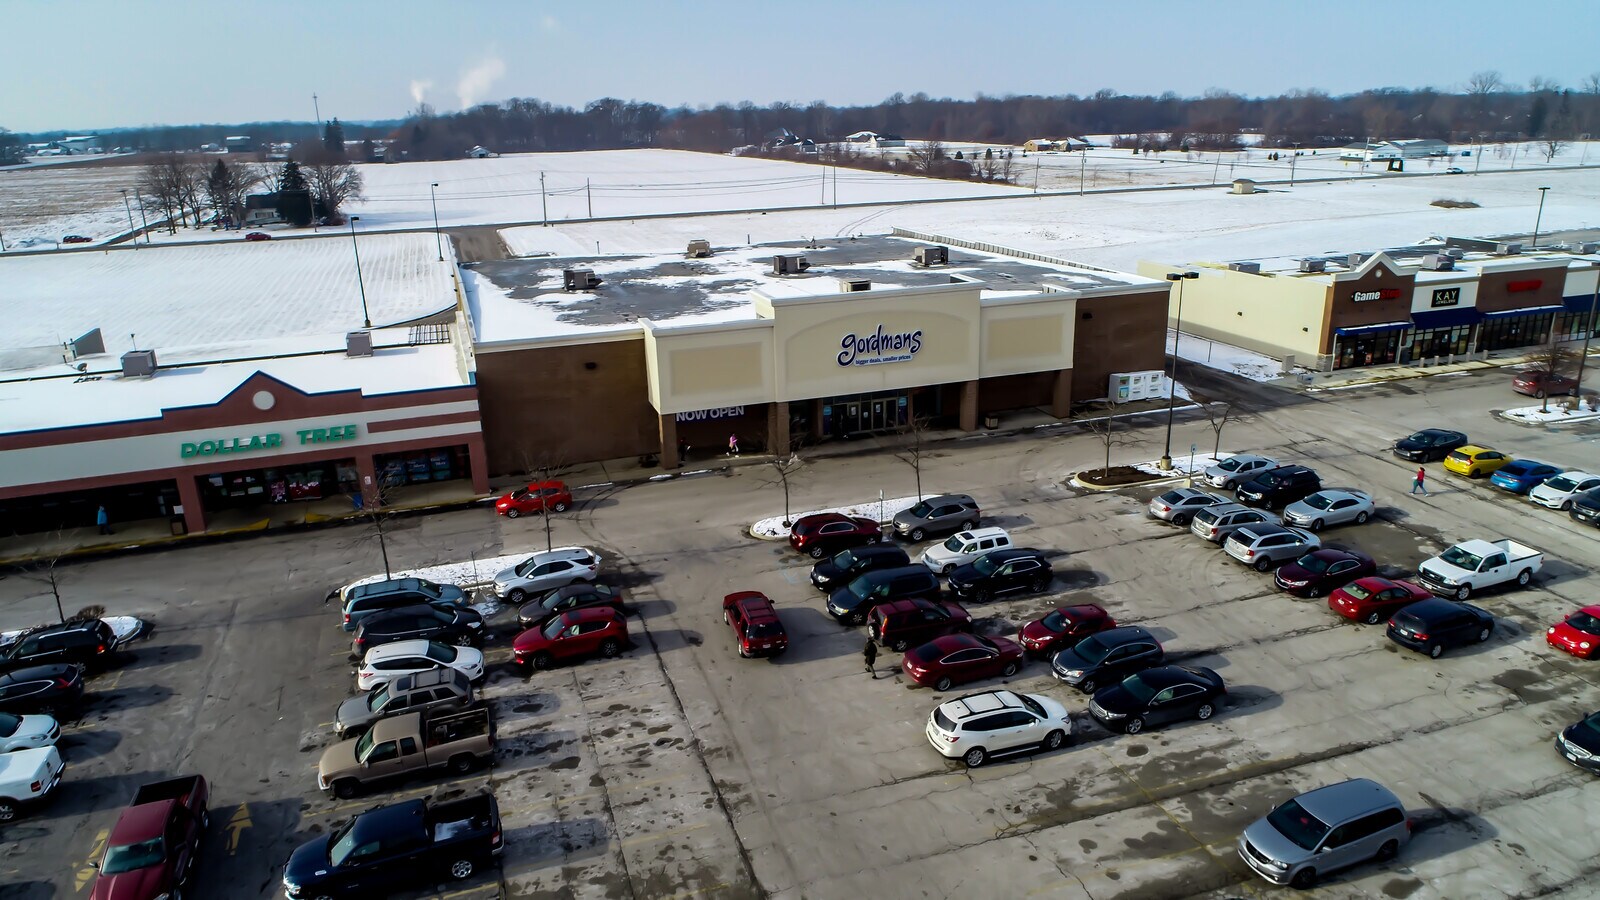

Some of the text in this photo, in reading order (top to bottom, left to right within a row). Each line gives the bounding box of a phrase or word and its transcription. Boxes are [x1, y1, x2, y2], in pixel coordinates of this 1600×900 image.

[1436, 290, 1457, 301] KAY
[837, 324, 922, 366] gordmans
[676, 406, 745, 421] NOW OPEN
[181, 424, 357, 458] DOLLAR TREE
